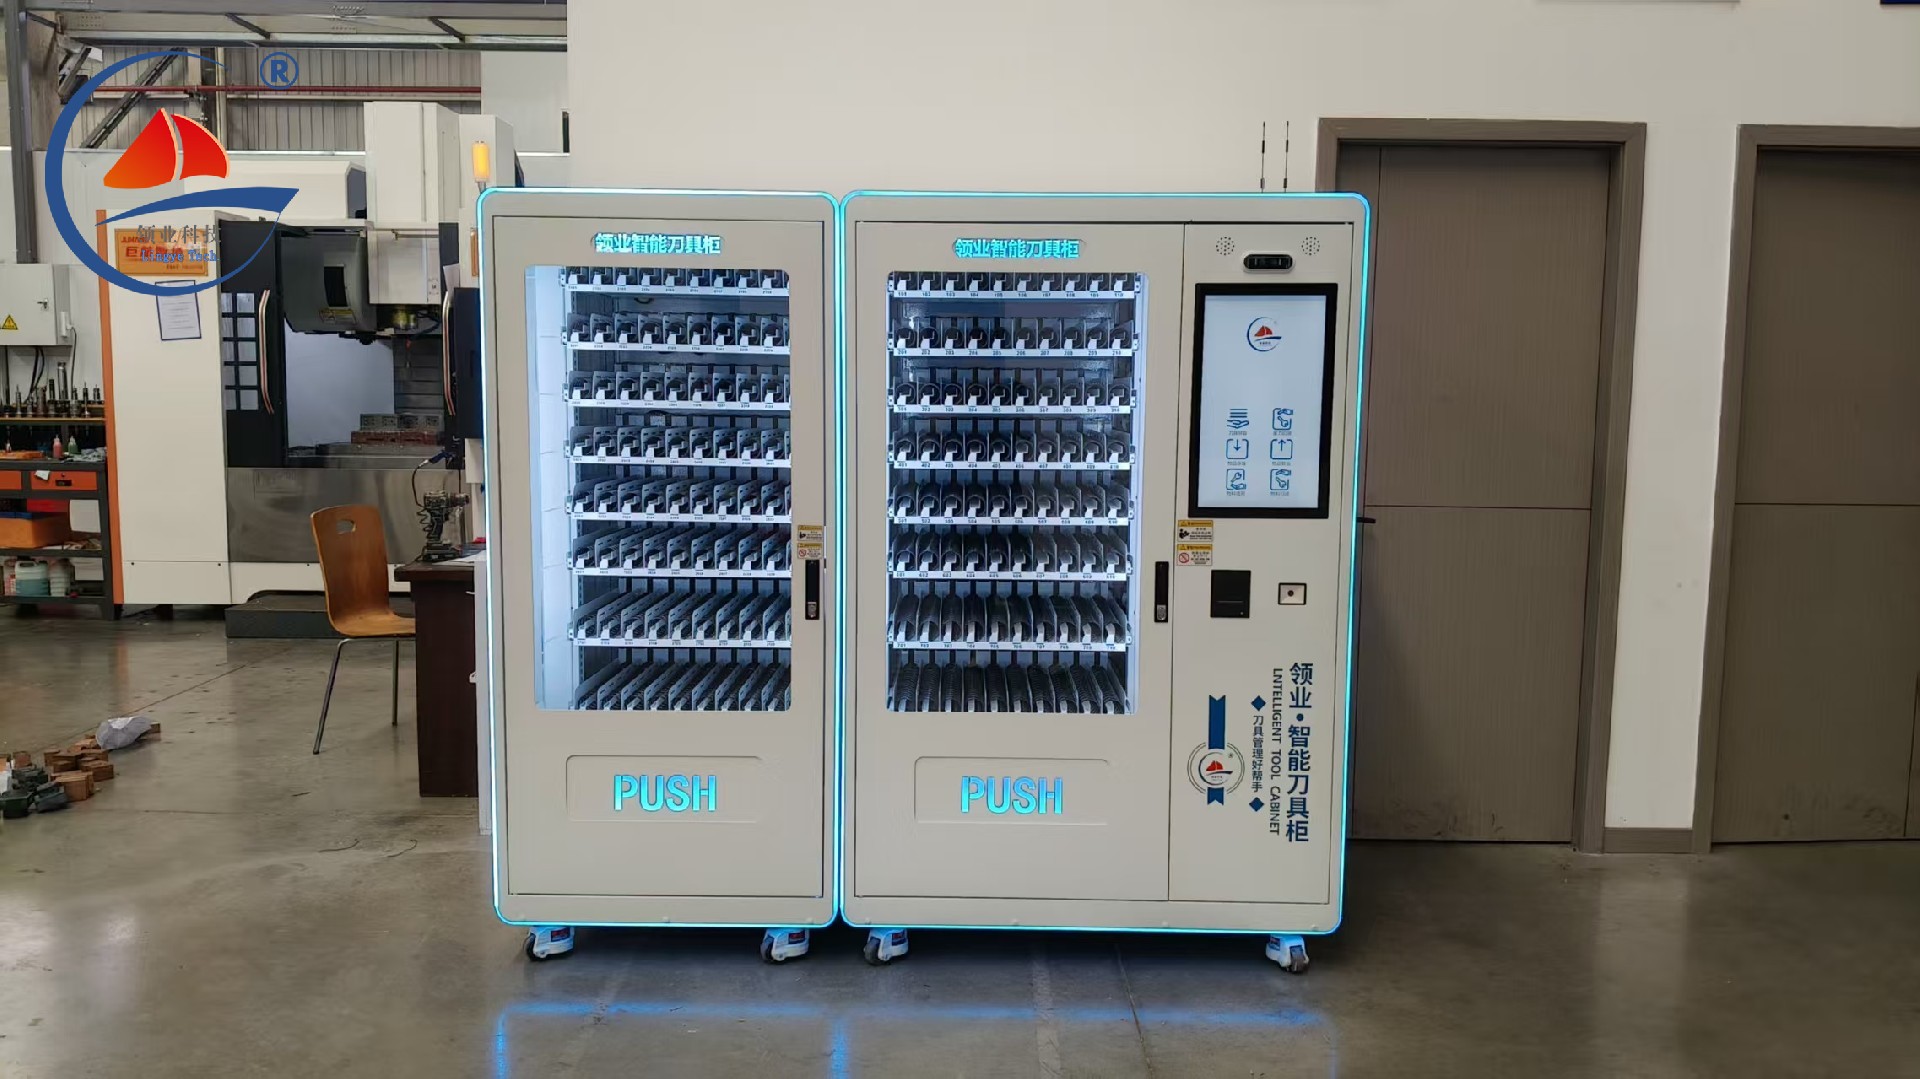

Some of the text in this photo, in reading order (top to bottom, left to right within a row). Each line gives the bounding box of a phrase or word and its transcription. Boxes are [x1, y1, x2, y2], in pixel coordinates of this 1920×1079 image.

[595, 232, 721, 254] 领业智能刀具柜
[955, 238, 1080, 259] 领业智能刀具柜
[1252, 715, 1264, 793] 刀具管理好帮手
[1270, 749, 1281, 781] TOOL
[613, 774, 717, 812] PUSH
[961, 775, 1063, 815] PUSH
[1269, 786, 1281, 836] CABINET
